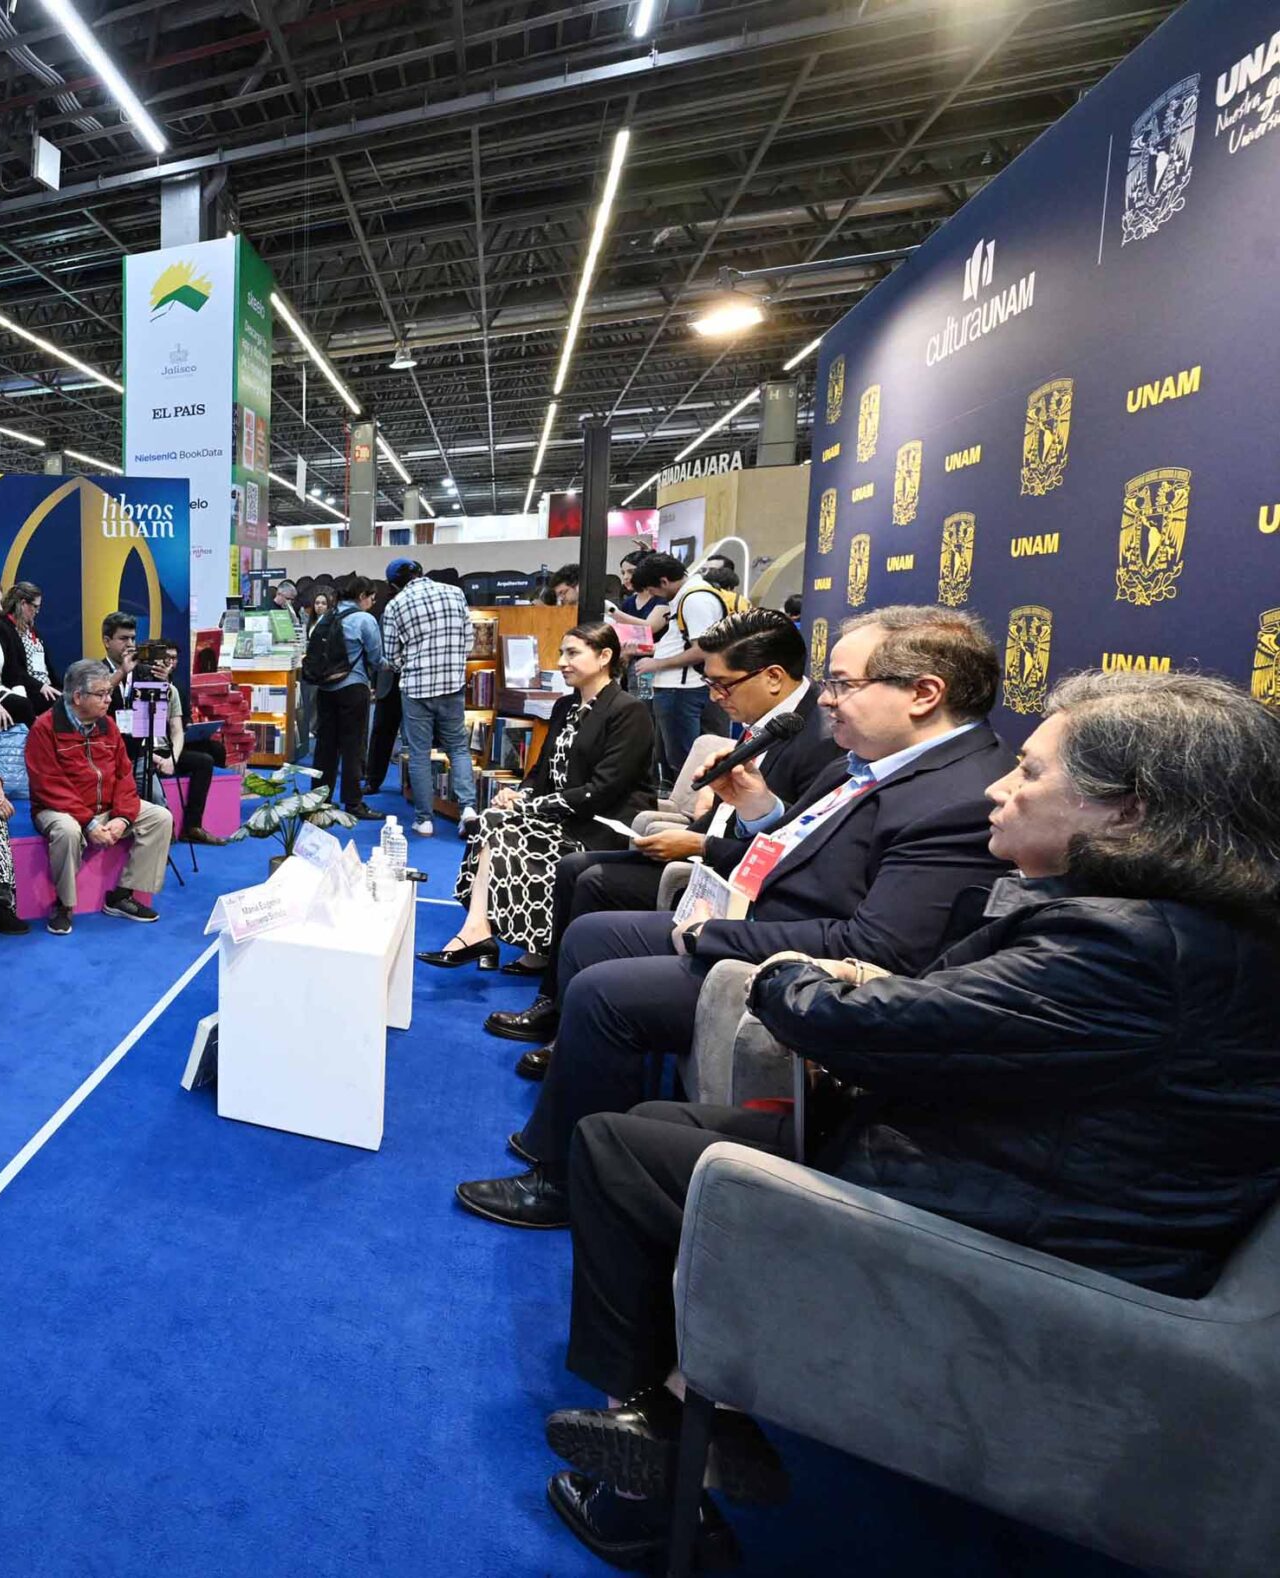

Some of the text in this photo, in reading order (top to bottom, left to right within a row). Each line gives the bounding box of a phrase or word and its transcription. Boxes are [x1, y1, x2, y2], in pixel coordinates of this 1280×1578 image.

[926, 271, 1036, 367] culturaUNAM
[160, 364, 197, 376] Jalisco
[769, 391, 780, 400] H
[1126, 366, 1202, 413] UNAM
[152, 408, 172, 420] EL
[135, 448, 224, 463] NielsenIQ BookData
[822, 442, 841, 463] UNAM
[945, 445, 982, 472] UNAM
[851, 483, 875, 503] UNAM
[103, 493, 174, 520] libros
[1010, 533, 1060, 558] UNAM
[886, 554, 915, 573] UNAM
[814, 577, 833, 591] UNAM
[1102, 652, 1171, 673] UNAM
